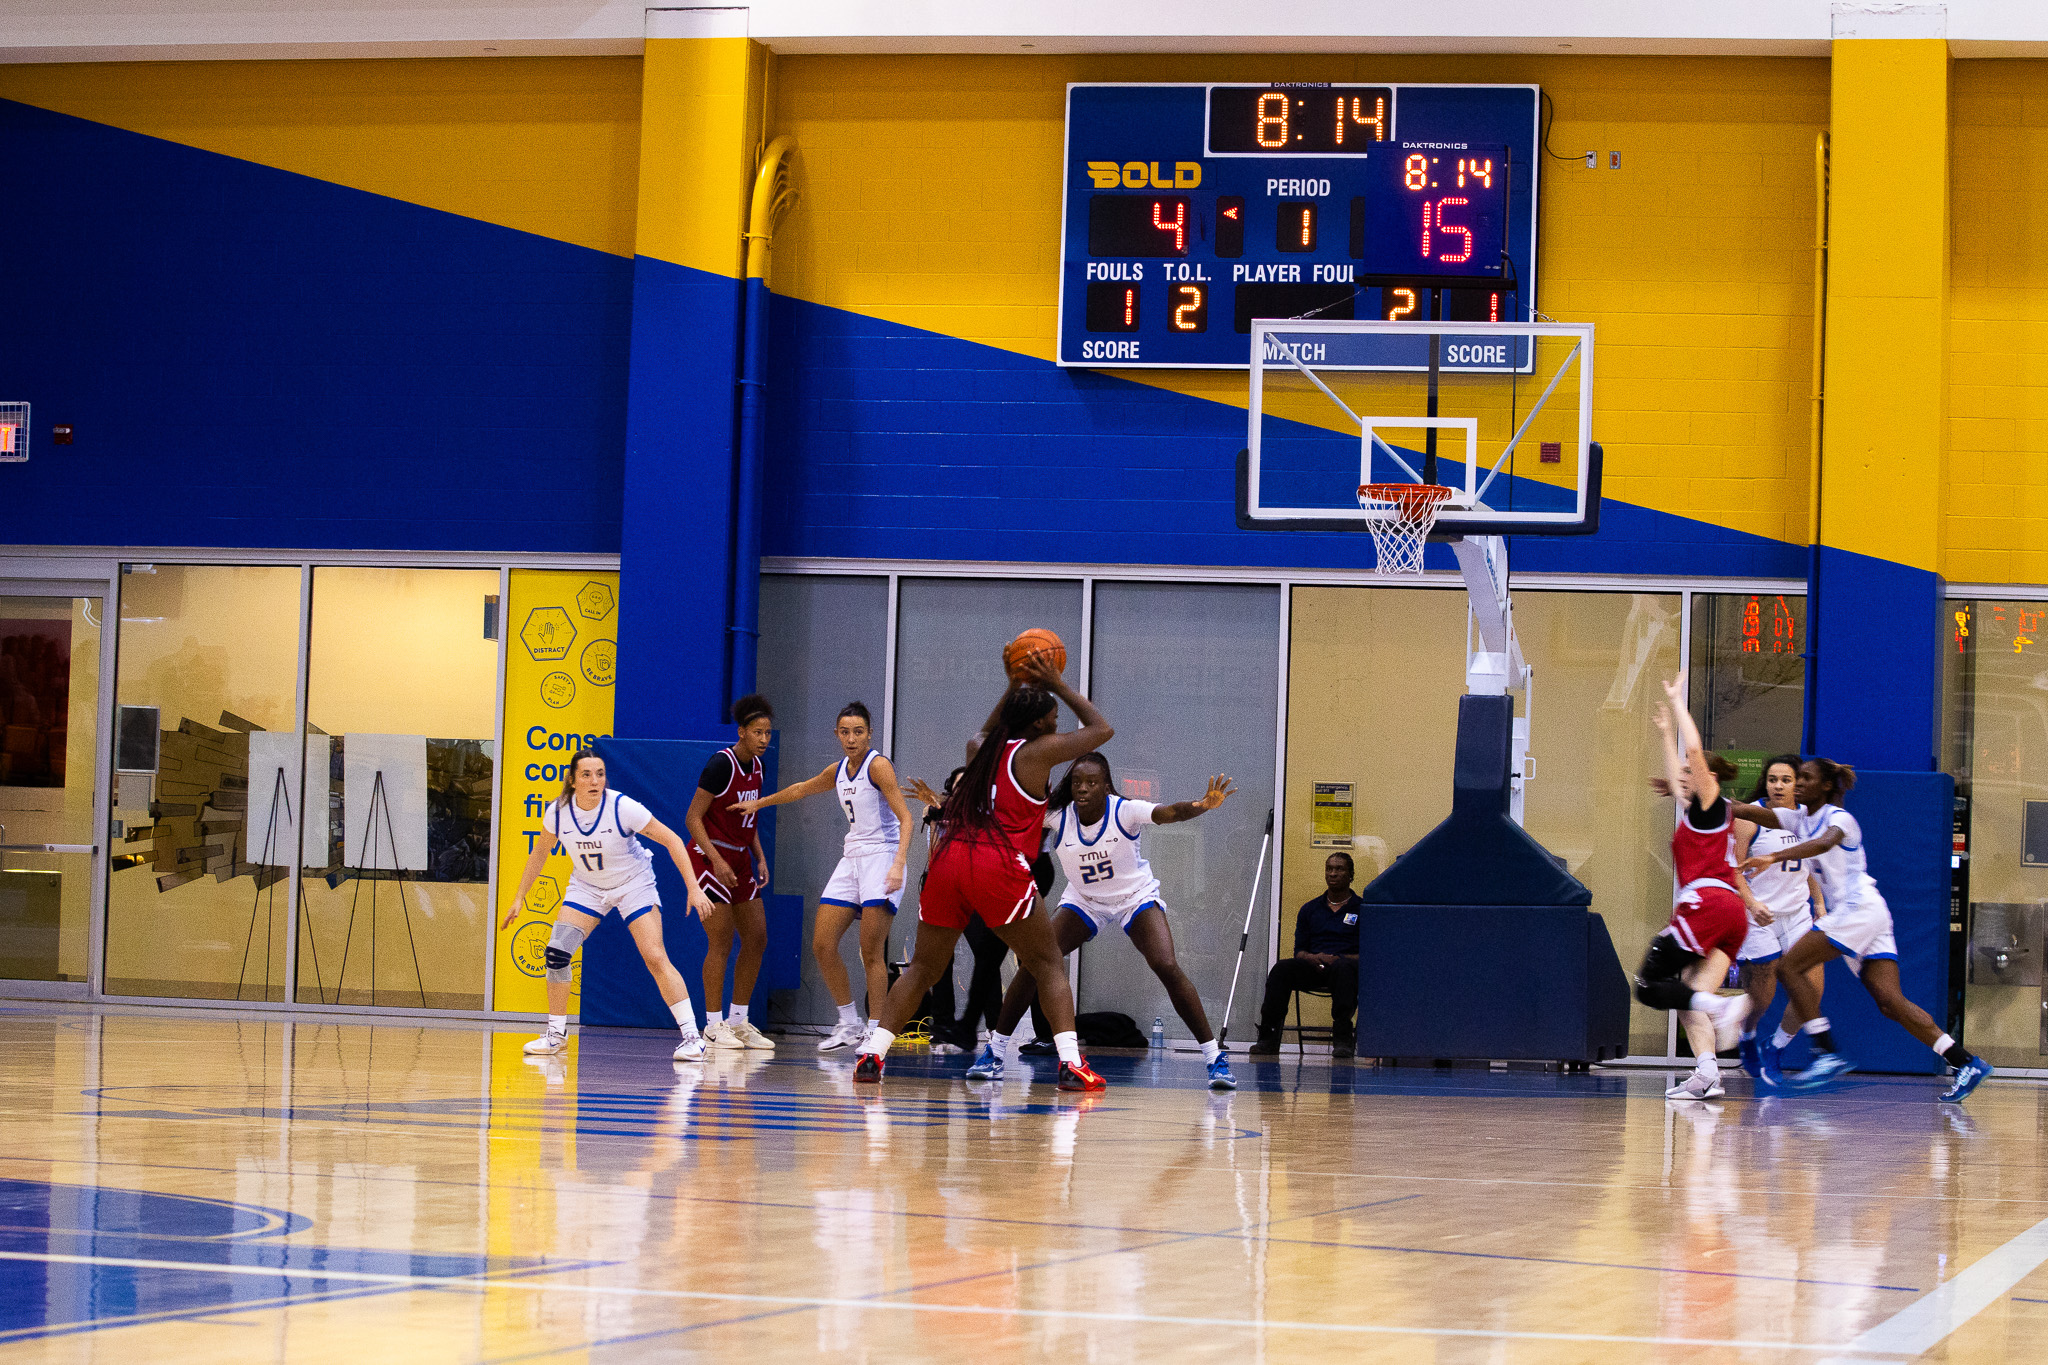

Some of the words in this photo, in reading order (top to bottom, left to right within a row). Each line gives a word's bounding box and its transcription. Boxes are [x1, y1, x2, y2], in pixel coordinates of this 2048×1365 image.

[1257, 92, 1384, 148] 8:14
[1402, 142, 1468, 150] DAKTRONICS
[1087, 161, 1202, 189] BOLD
[1405, 153, 1492, 191] 8:14
[1266, 178, 1331, 197] PERIOD
[1153, 202, 1184, 250] 4
[1302, 208, 1311, 246] 1
[1421, 197, 1472, 262] 15
[1086, 262, 1144, 281] FOULS
[1163, 263, 1212, 282] T.O.L.
[1233, 264, 1301, 283] PLAYER
[1125, 289, 1133, 326] 1
[1175, 286, 1201, 329] 2
[1082, 340, 1140, 359] SCORE
[1263, 342, 1326, 361] MATCH
[1447, 344, 1506, 364] SCORE
[533, 646, 565, 654] DISTRACT
[586, 667, 593, 676] BE
[845, 800, 855, 823] 3
[575, 841, 602, 850] TMU
[580, 852, 604, 872] 17
[1079, 850, 1109, 862] TMU
[1079, 860, 1115, 885] 25
